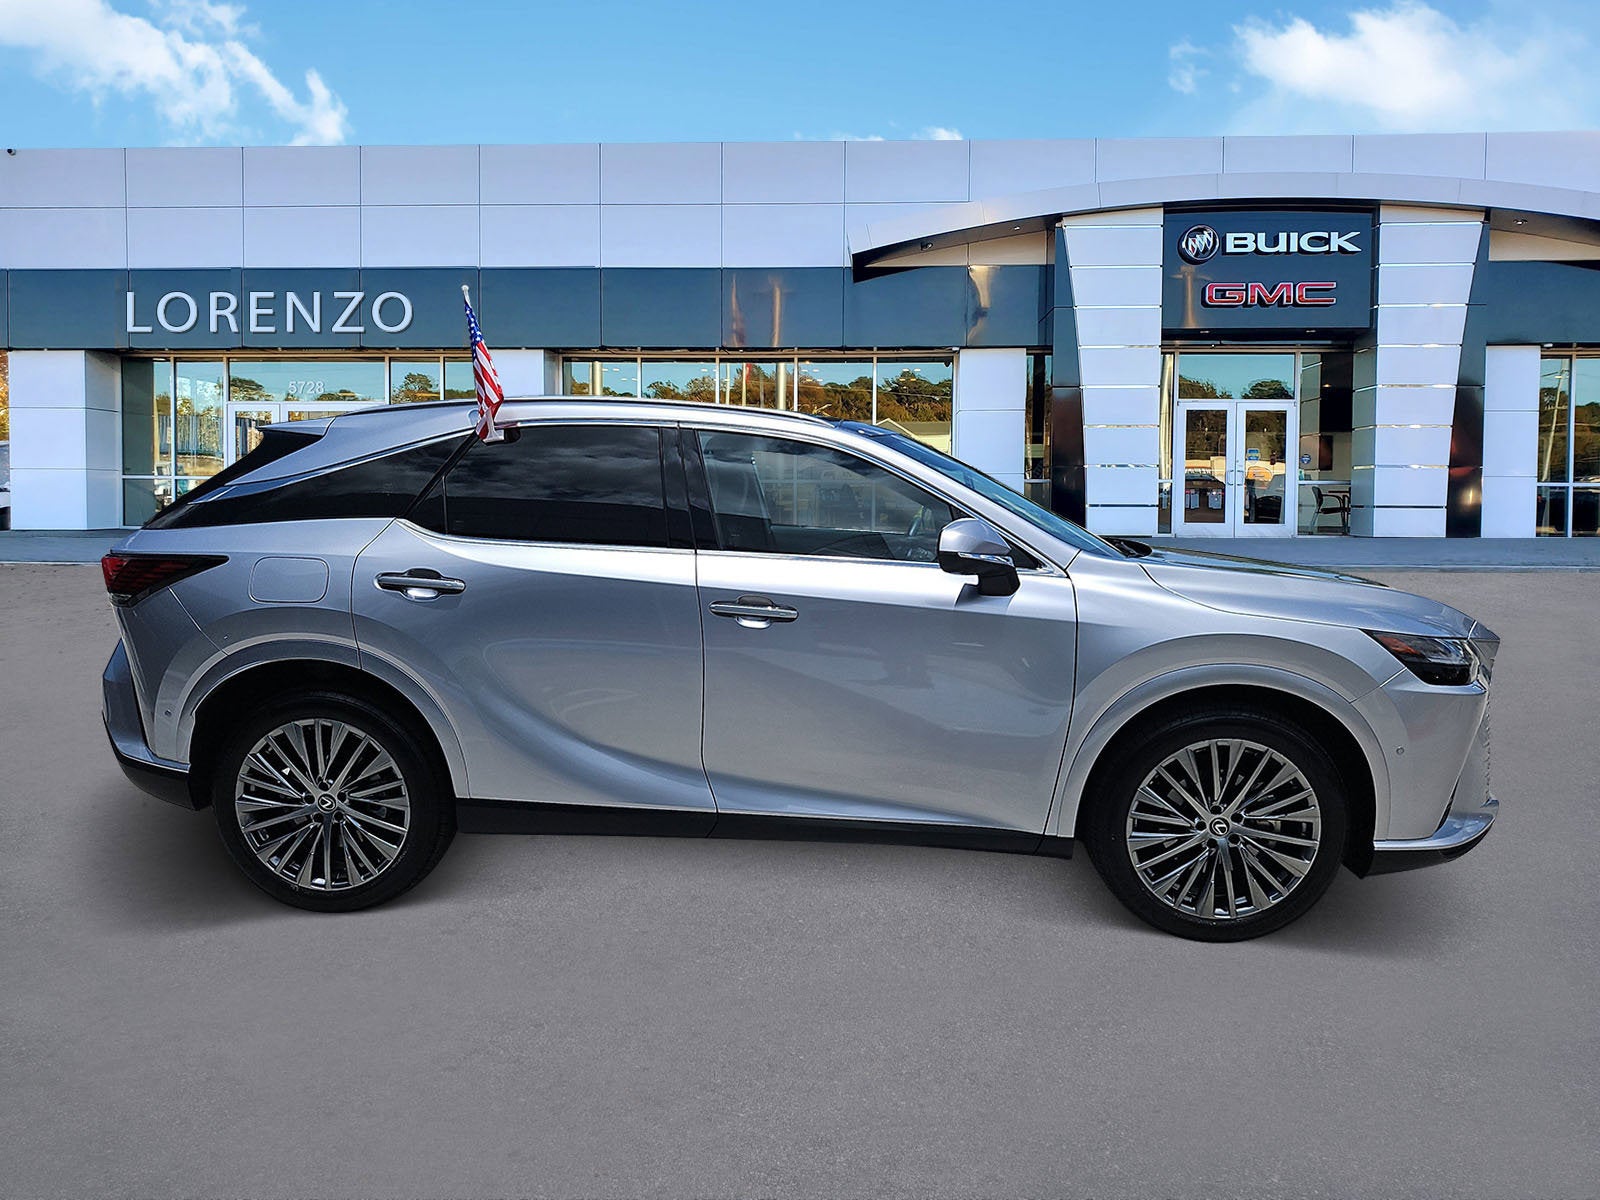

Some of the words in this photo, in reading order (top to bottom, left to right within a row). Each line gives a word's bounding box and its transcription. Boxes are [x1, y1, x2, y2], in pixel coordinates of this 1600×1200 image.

[1225, 231, 1362, 252] BUICK
[1205, 282, 1337, 305] GMC
[126, 291, 413, 333] LORENZO
[288, 380, 325, 394] 5728
